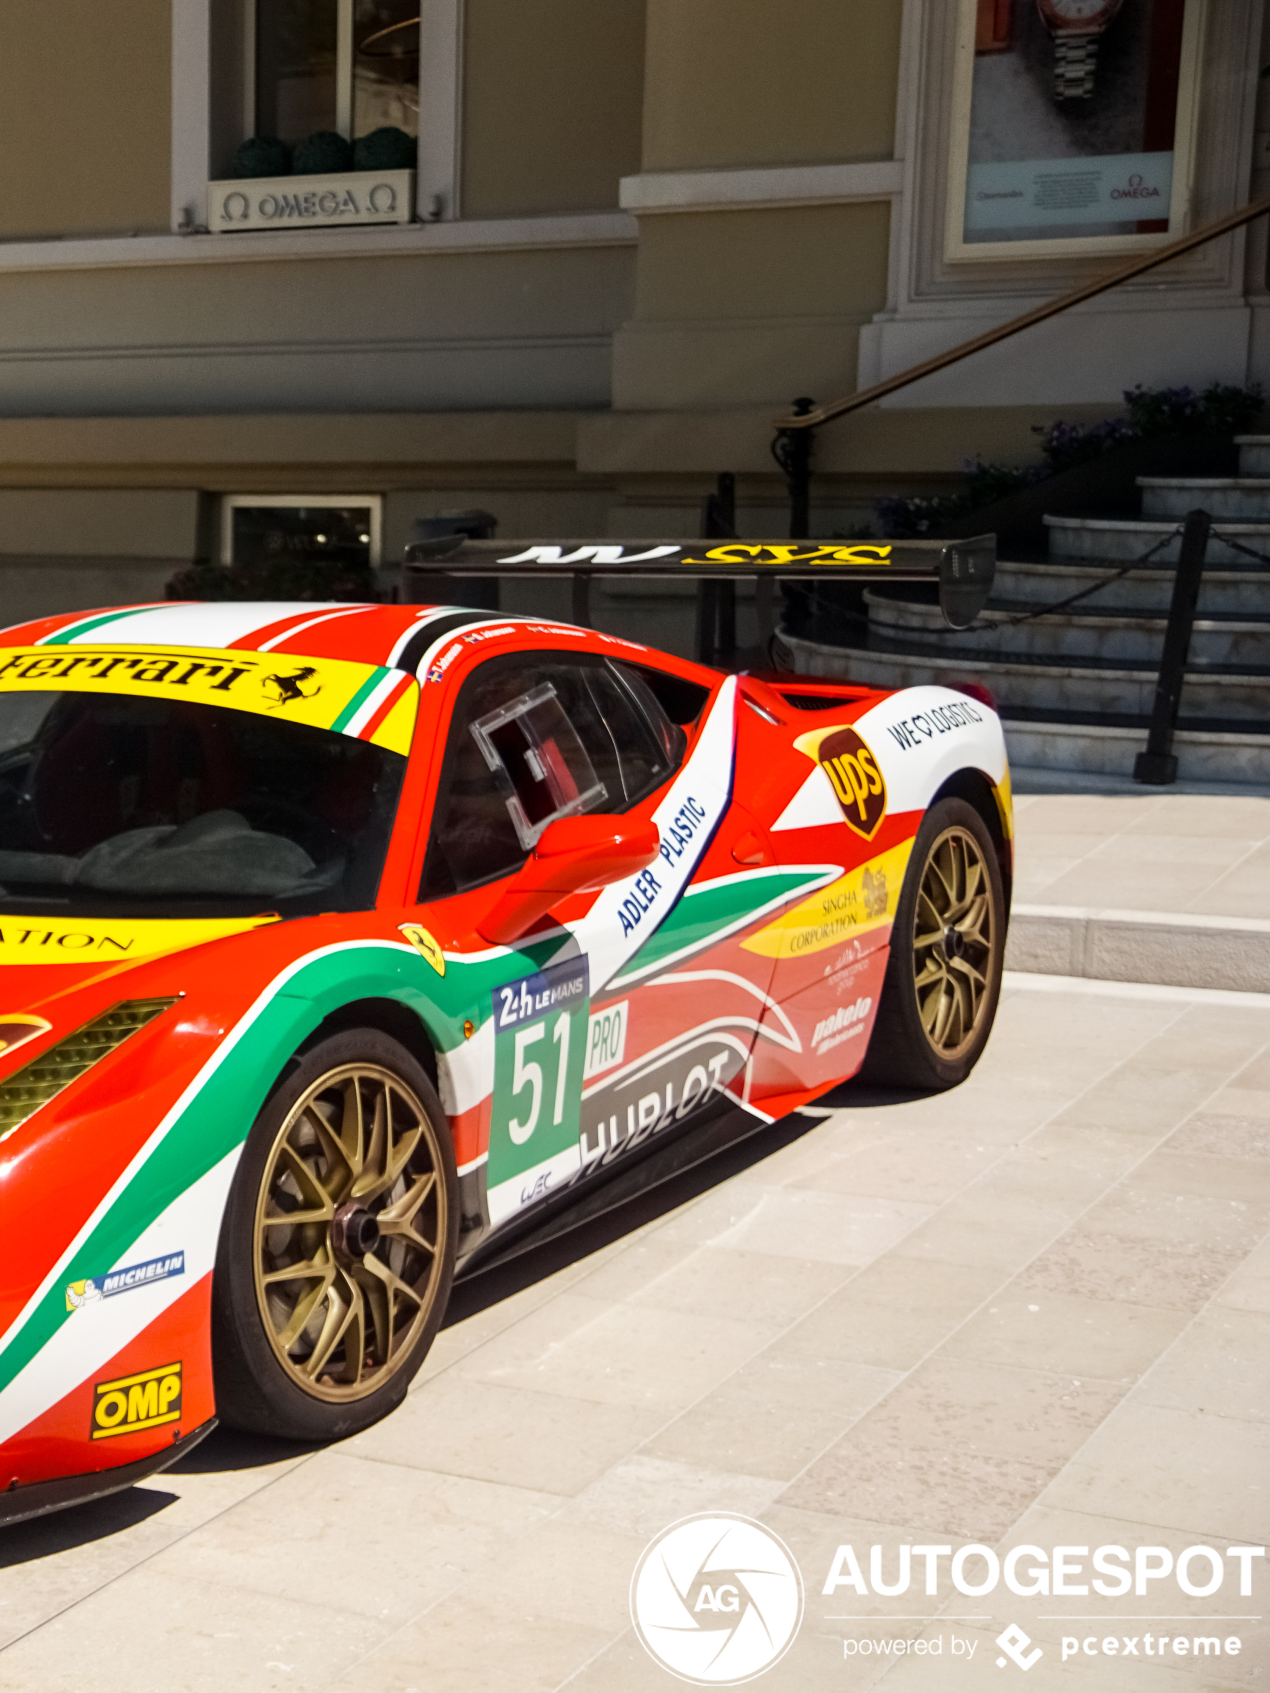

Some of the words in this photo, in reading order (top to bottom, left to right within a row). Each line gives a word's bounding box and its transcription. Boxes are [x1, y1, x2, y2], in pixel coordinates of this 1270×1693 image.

[258, 189, 360, 219] OMEGA
[1109, 187, 1160, 200] OMEGA
[887, 720, 922, 751] WE
[924, 701, 983, 734] LOGISTICS
[616, 868, 662, 938] ADLER
[659, 796, 706, 868] PLASTIC
[822, 889, 857, 917] SINGHA
[790, 909, 858, 953] CORPORATION
[589, 1010, 621, 1070] PRO
[810, 997, 872, 1048] pakelo
[508, 1011, 571, 1145] 51
[569, 1050, 729, 1187] HUBLOT
[102, 1255, 183, 1292] MICHELIN
[95, 1374, 181, 1428] OMP
